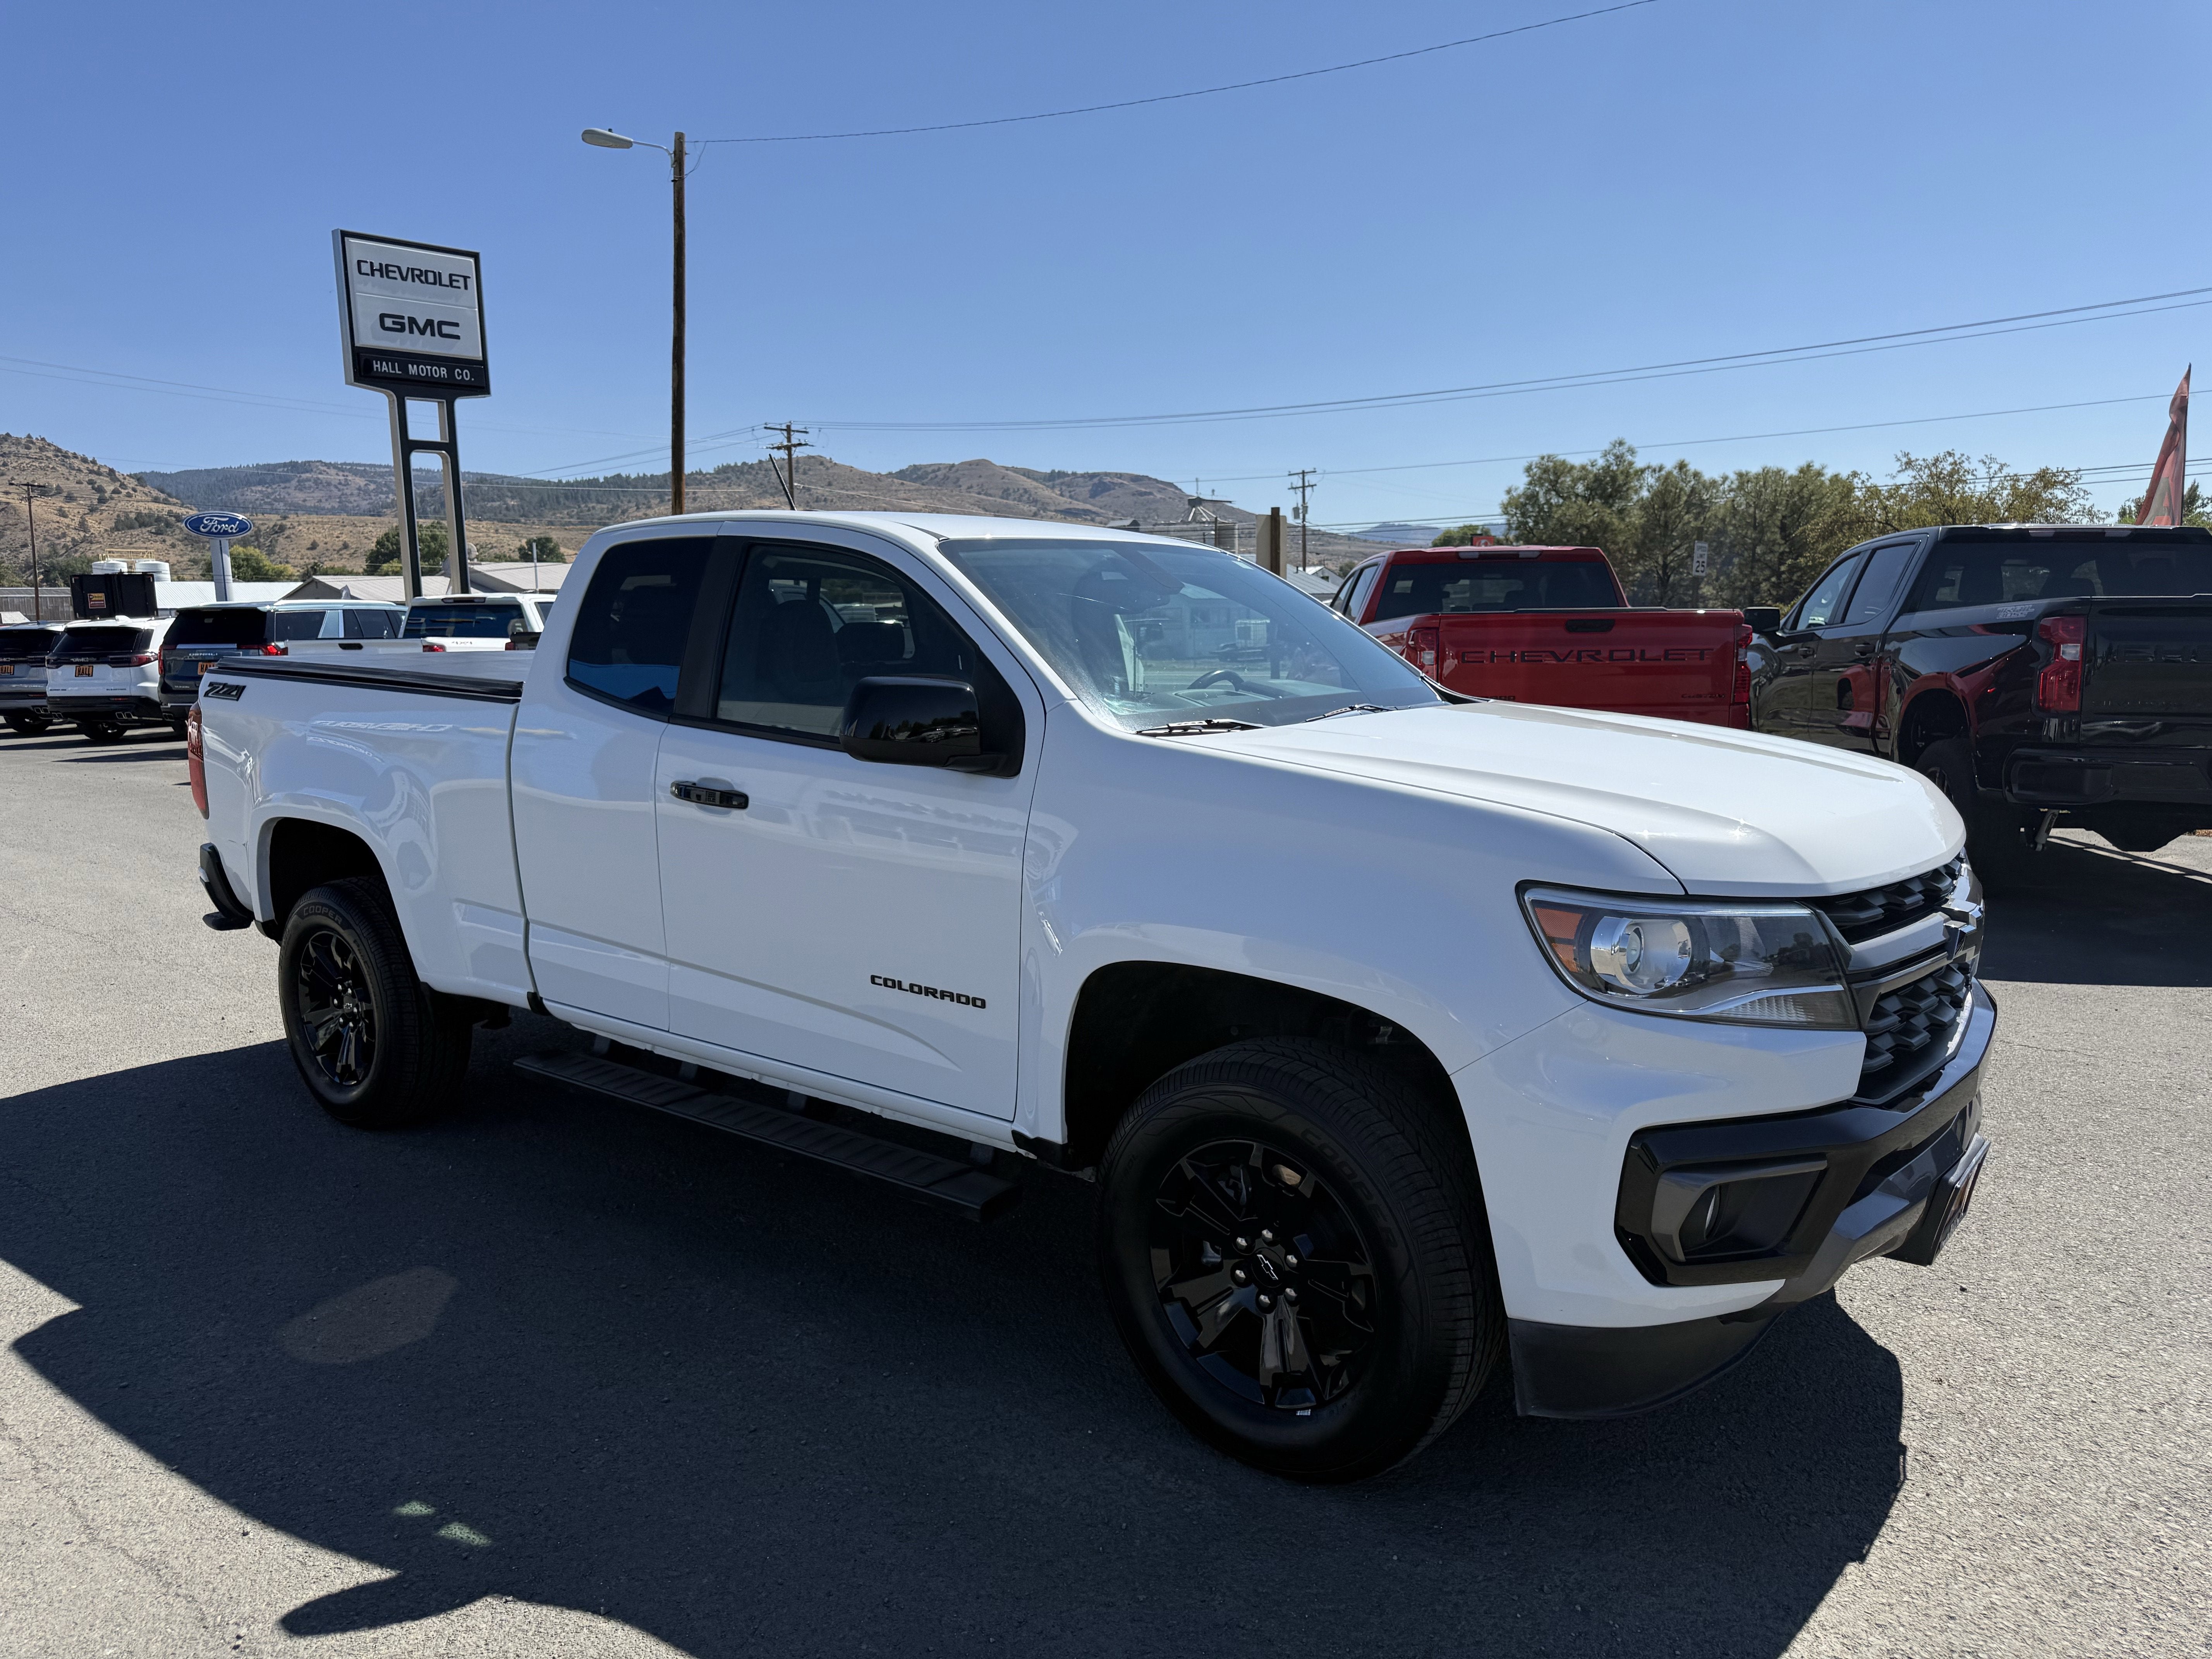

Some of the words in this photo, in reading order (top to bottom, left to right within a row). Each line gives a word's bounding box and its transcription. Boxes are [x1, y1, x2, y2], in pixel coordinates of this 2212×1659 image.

[357, 259, 471, 290] CHEVROLET
[379, 313, 461, 340] GMC
[373, 360, 402, 374] HALL
[409, 364, 447, 378] MOTOR
[455, 369, 474, 381] CO.
[199, 517, 239, 533] Ford
[1695, 560, 1705, 573] 25
[1461, 648, 1715, 664] CHEVROLET
[77, 666, 91, 676] HALL
[303, 905, 343, 925] COOPER
[870, 974, 986, 1009] COLORADO
[1300, 1127, 1398, 1248] COOPER
